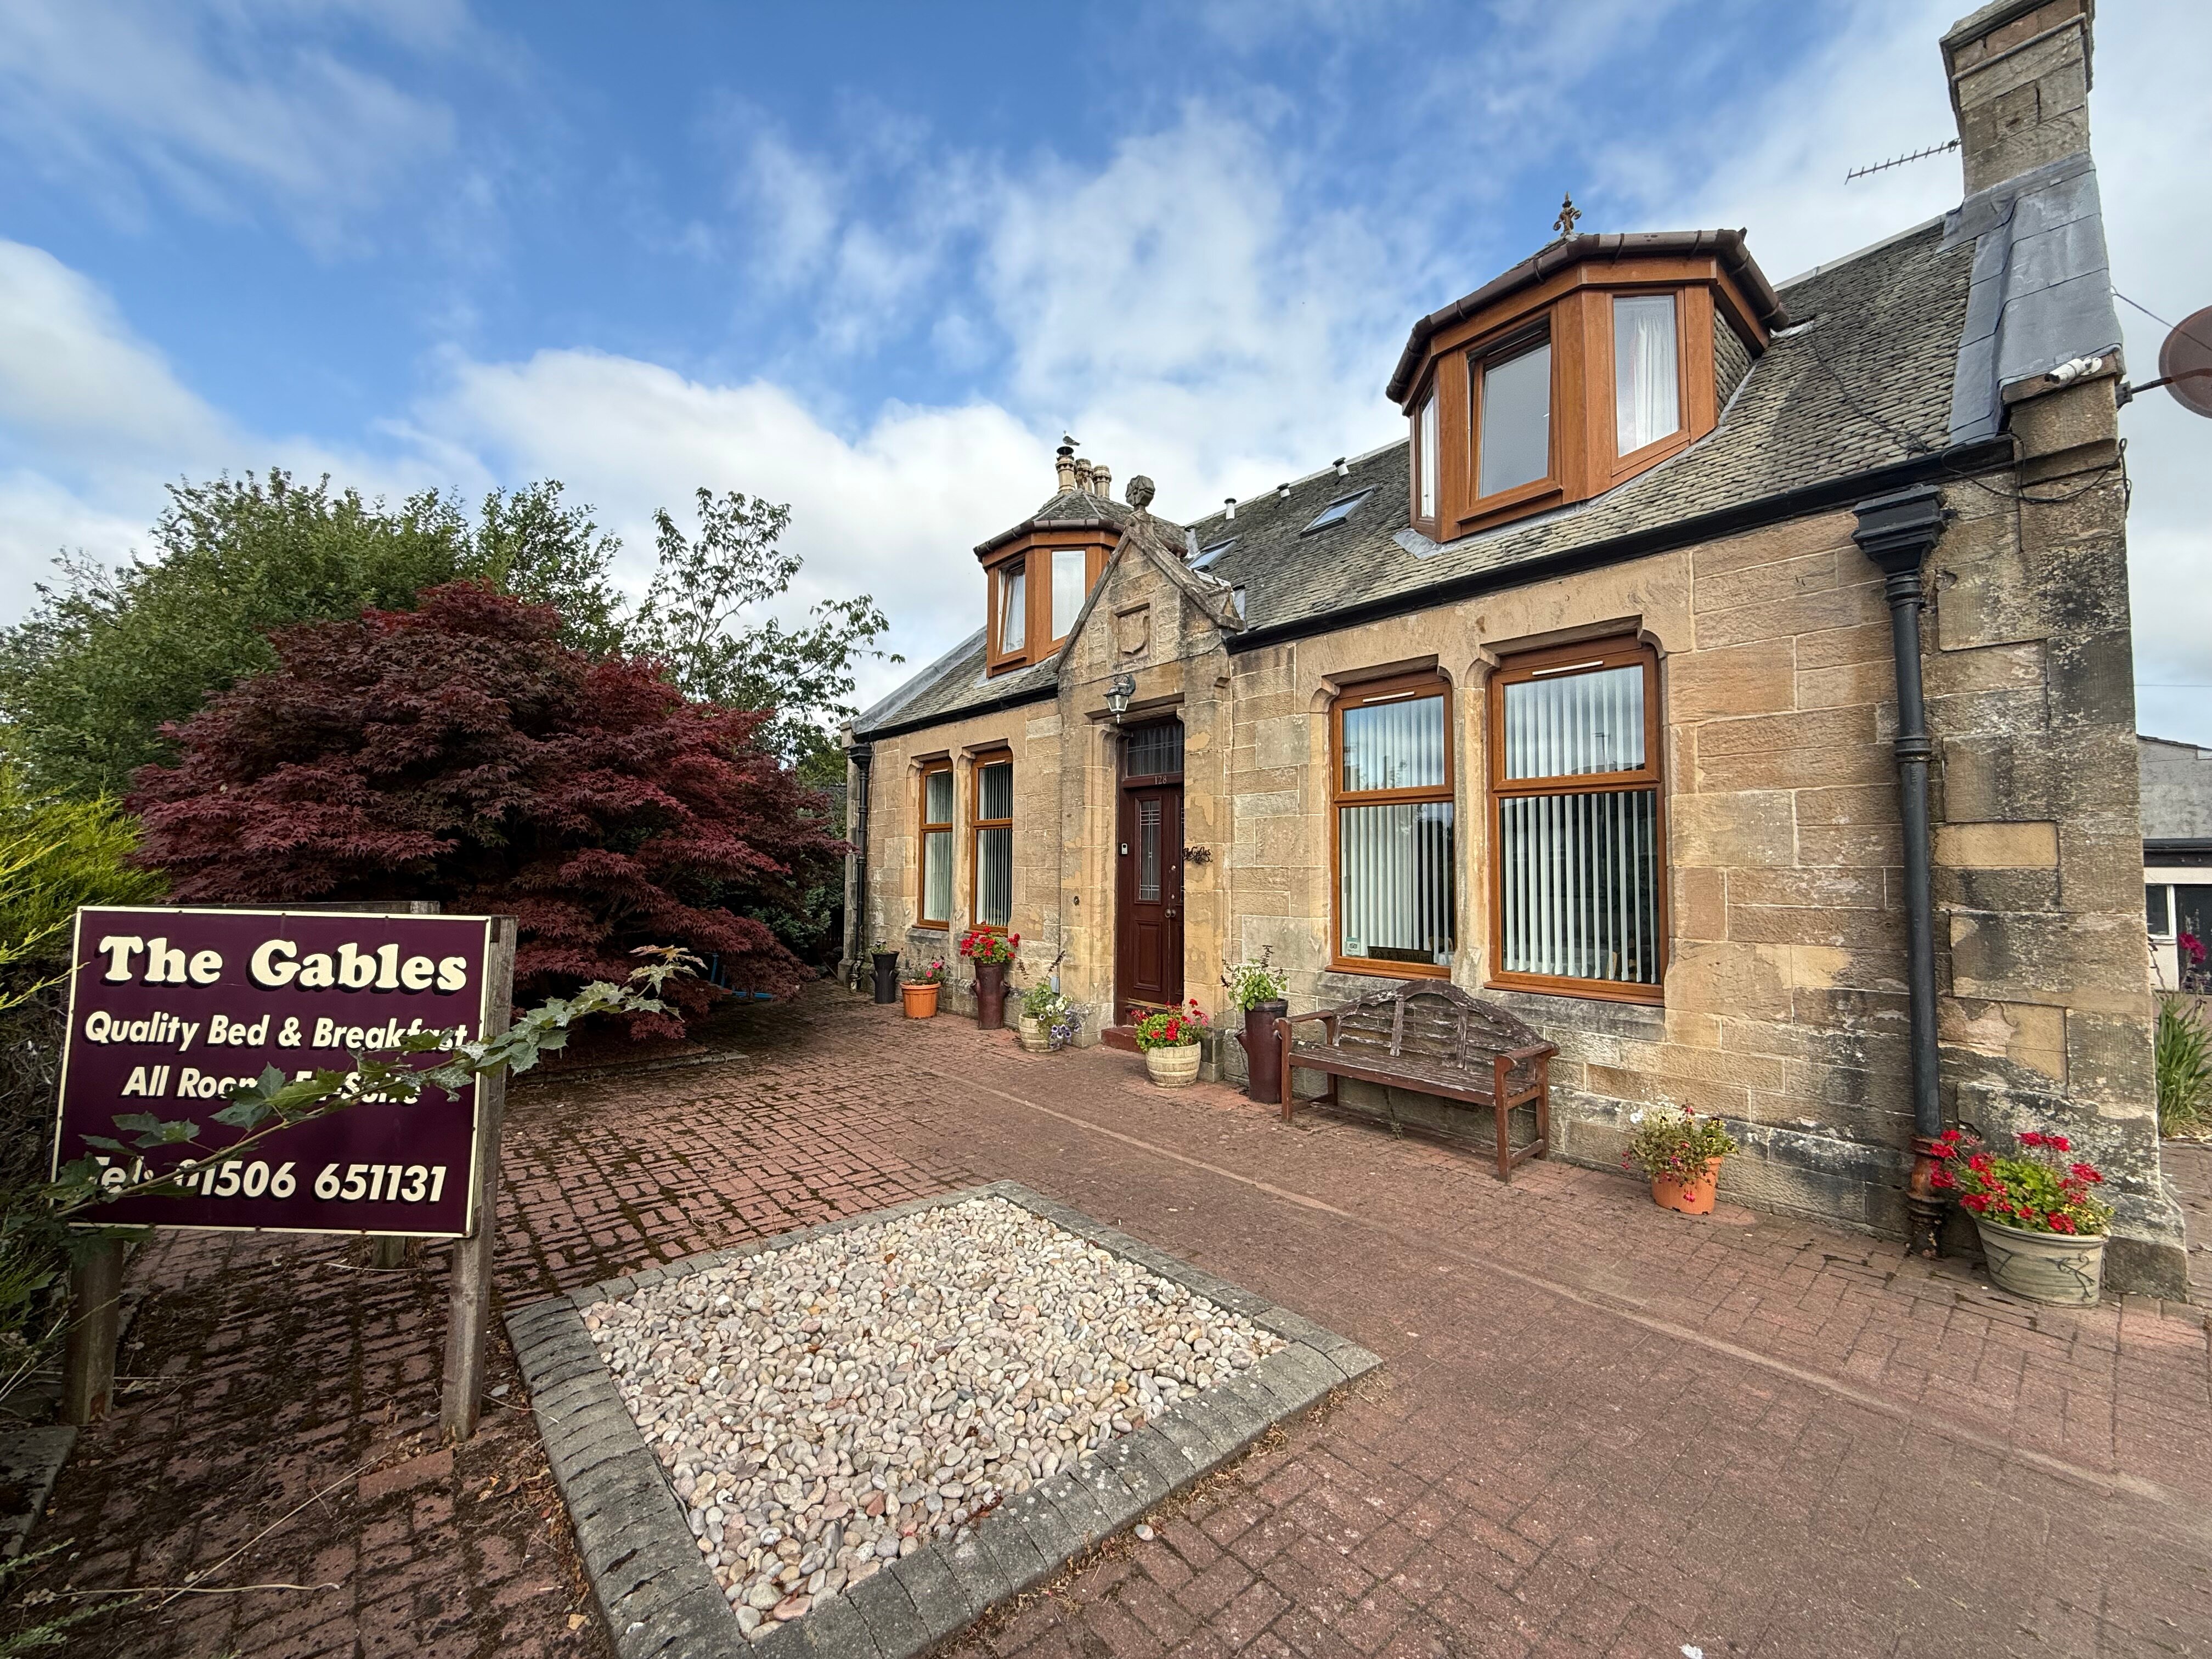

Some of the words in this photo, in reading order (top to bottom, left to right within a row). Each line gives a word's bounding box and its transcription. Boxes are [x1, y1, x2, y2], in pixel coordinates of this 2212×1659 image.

[1155, 775, 1167, 785] 128
[99, 935, 223, 984] The
[251, 939, 467, 991] Gables
[1369, 949, 1384, 958] Bed
[1395, 950, 1431, 963] Breakfast
[85, 1011, 200, 1052] Quality
[207, 1014, 270, 1046] Bed
[278, 1017, 302, 1047] &
[121, 1065, 170, 1096] All
[177, 1068, 264, 1098] Roo
[314, 1163, 447, 1203] 651131
